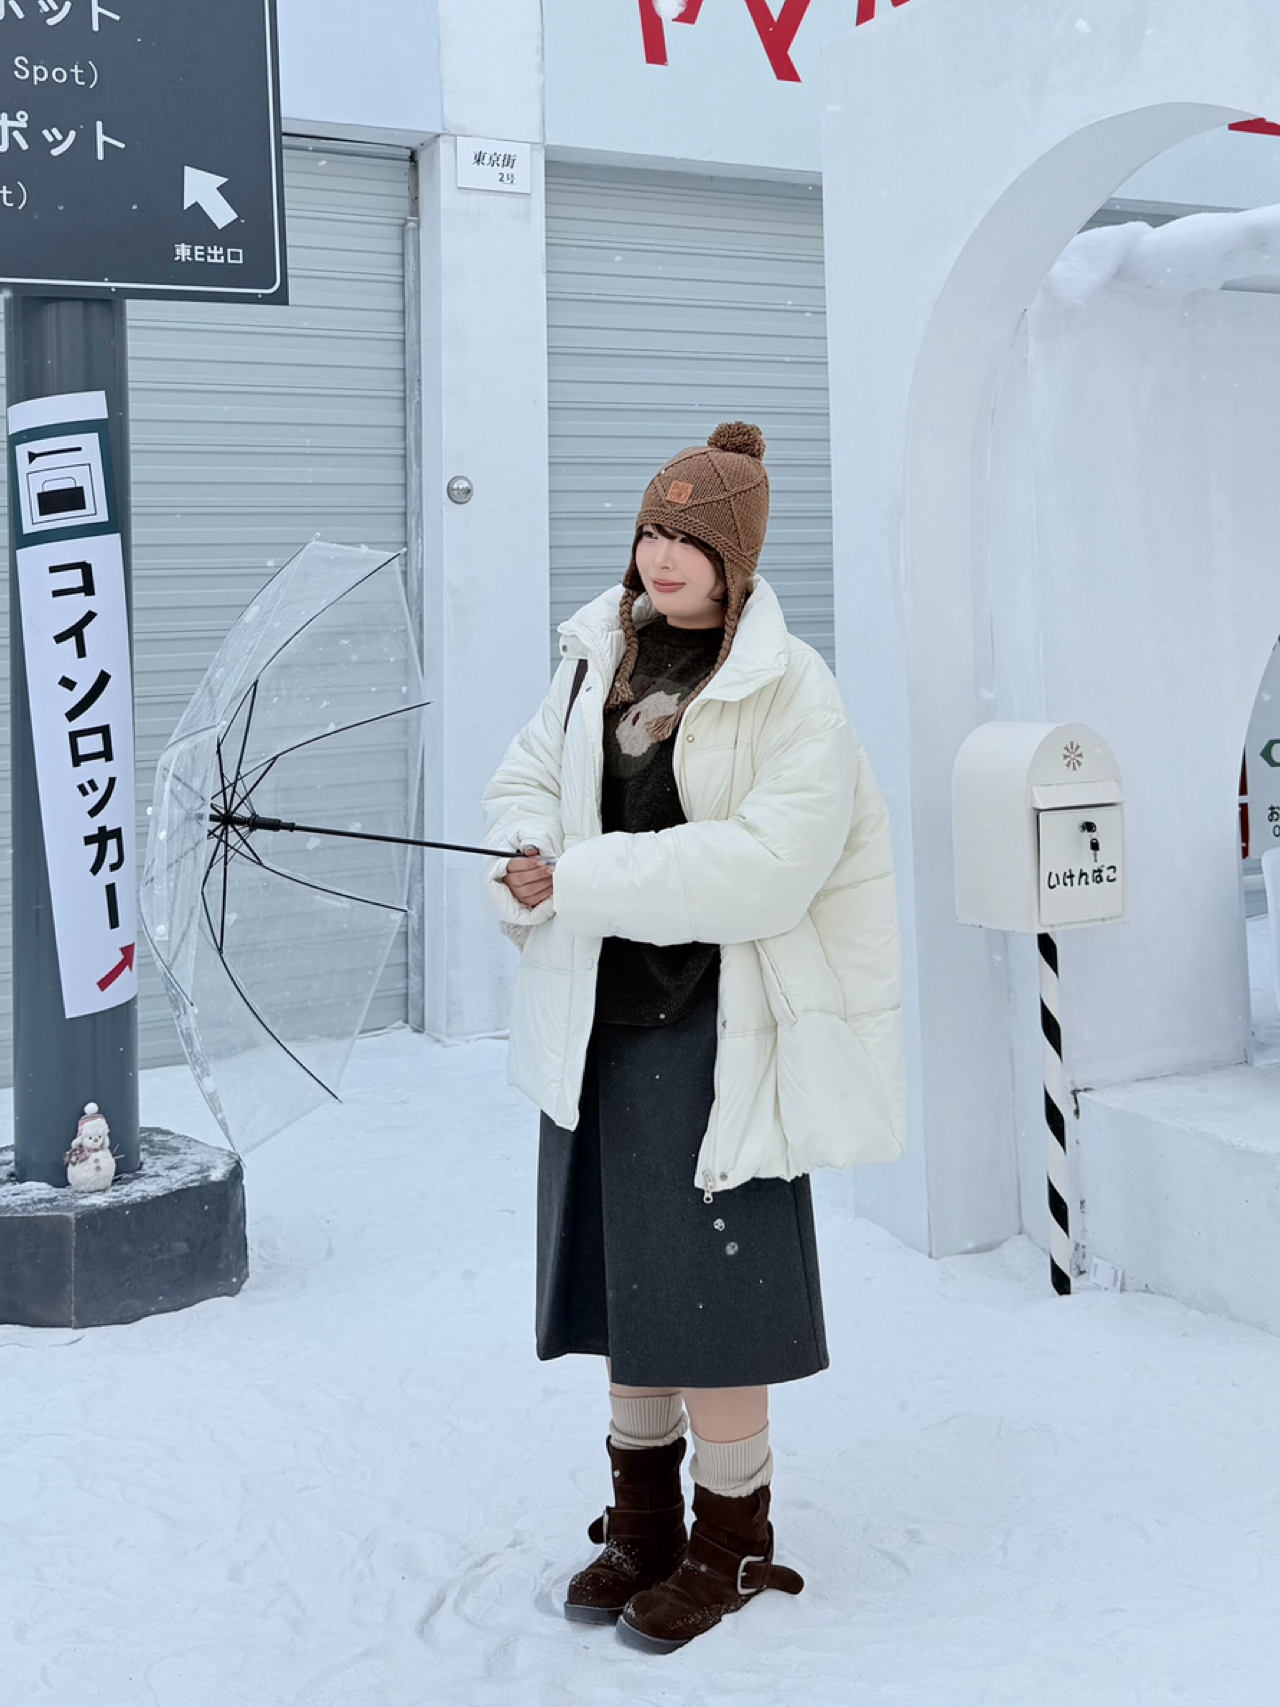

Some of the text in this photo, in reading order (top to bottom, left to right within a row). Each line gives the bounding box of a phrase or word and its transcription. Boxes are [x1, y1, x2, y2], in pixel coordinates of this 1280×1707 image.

[14, 56, 98, 89] Spot)
[471, 151, 517, 169] 東京街
[174, 243, 243, 264] 東E出口
[48, 561, 125, 930] コインロッカー
